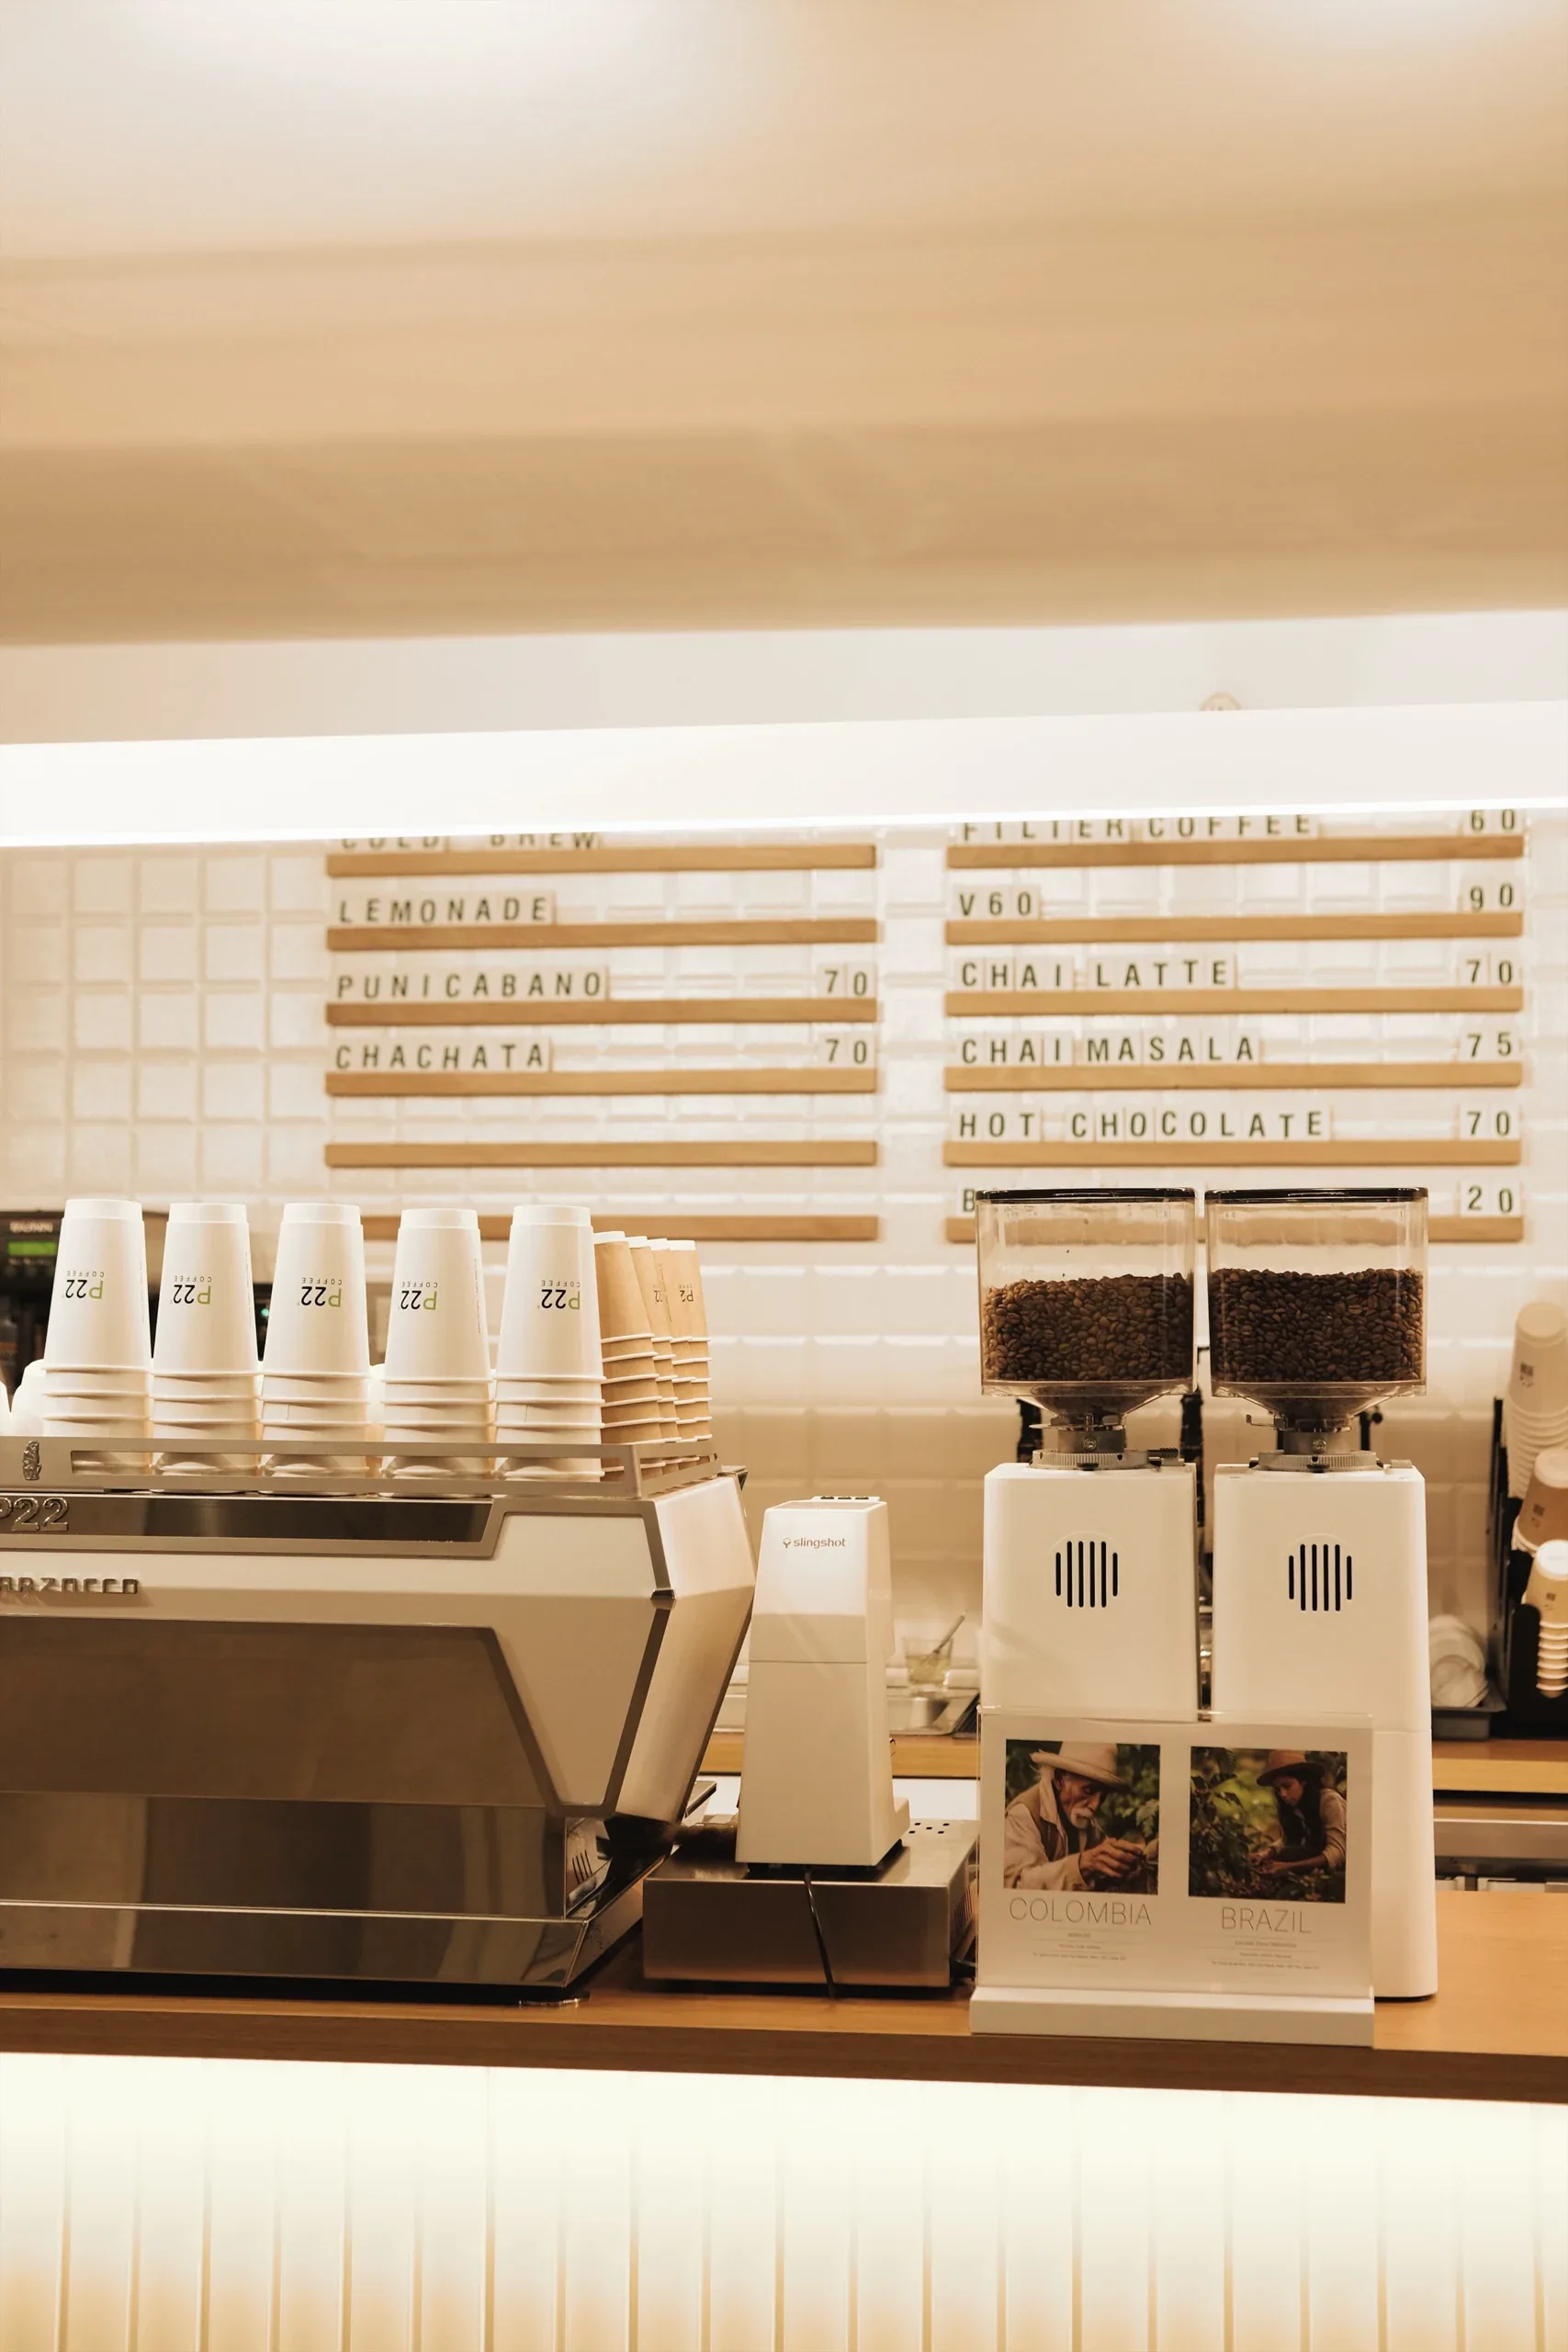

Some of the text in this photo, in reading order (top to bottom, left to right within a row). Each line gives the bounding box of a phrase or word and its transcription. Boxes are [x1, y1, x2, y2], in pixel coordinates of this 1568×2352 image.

[1471, 808, 1515, 831] 60
[340, 897, 546, 923] LEMONADE
[960, 884, 1514, 917] V60 90
[337, 969, 867, 999] PUNICABANO 70
[962, 959, 1513, 988] CHAI LATTE 70
[336, 1038, 867, 1070] CHACHATA 70
[962, 1032, 1513, 1065] CHAI MASALA 75
[960, 1110, 1511, 1138] HOT CHOCOLATE 70
[1467, 1185, 1514, 1214] 20
[66, 1270, 105, 1278] COFFEE
[301, 1277, 343, 1285] COFFEE
[401, 1281, 438, 1289] COFFEE
[541, 1280, 581, 1288] COFFEE
[65, 1279, 104, 1300] P22
[173, 1284, 212, 1305] P22
[300, 1286, 342, 1307] P22
[400, 1290, 438, 1310] P22
[541, 1289, 581, 1311] P22
[793, 1537, 847, 1549] slingshot
[1009, 1896, 1152, 1926] COLOMBIA
[1222, 1906, 1312, 1934] BRAZIL
